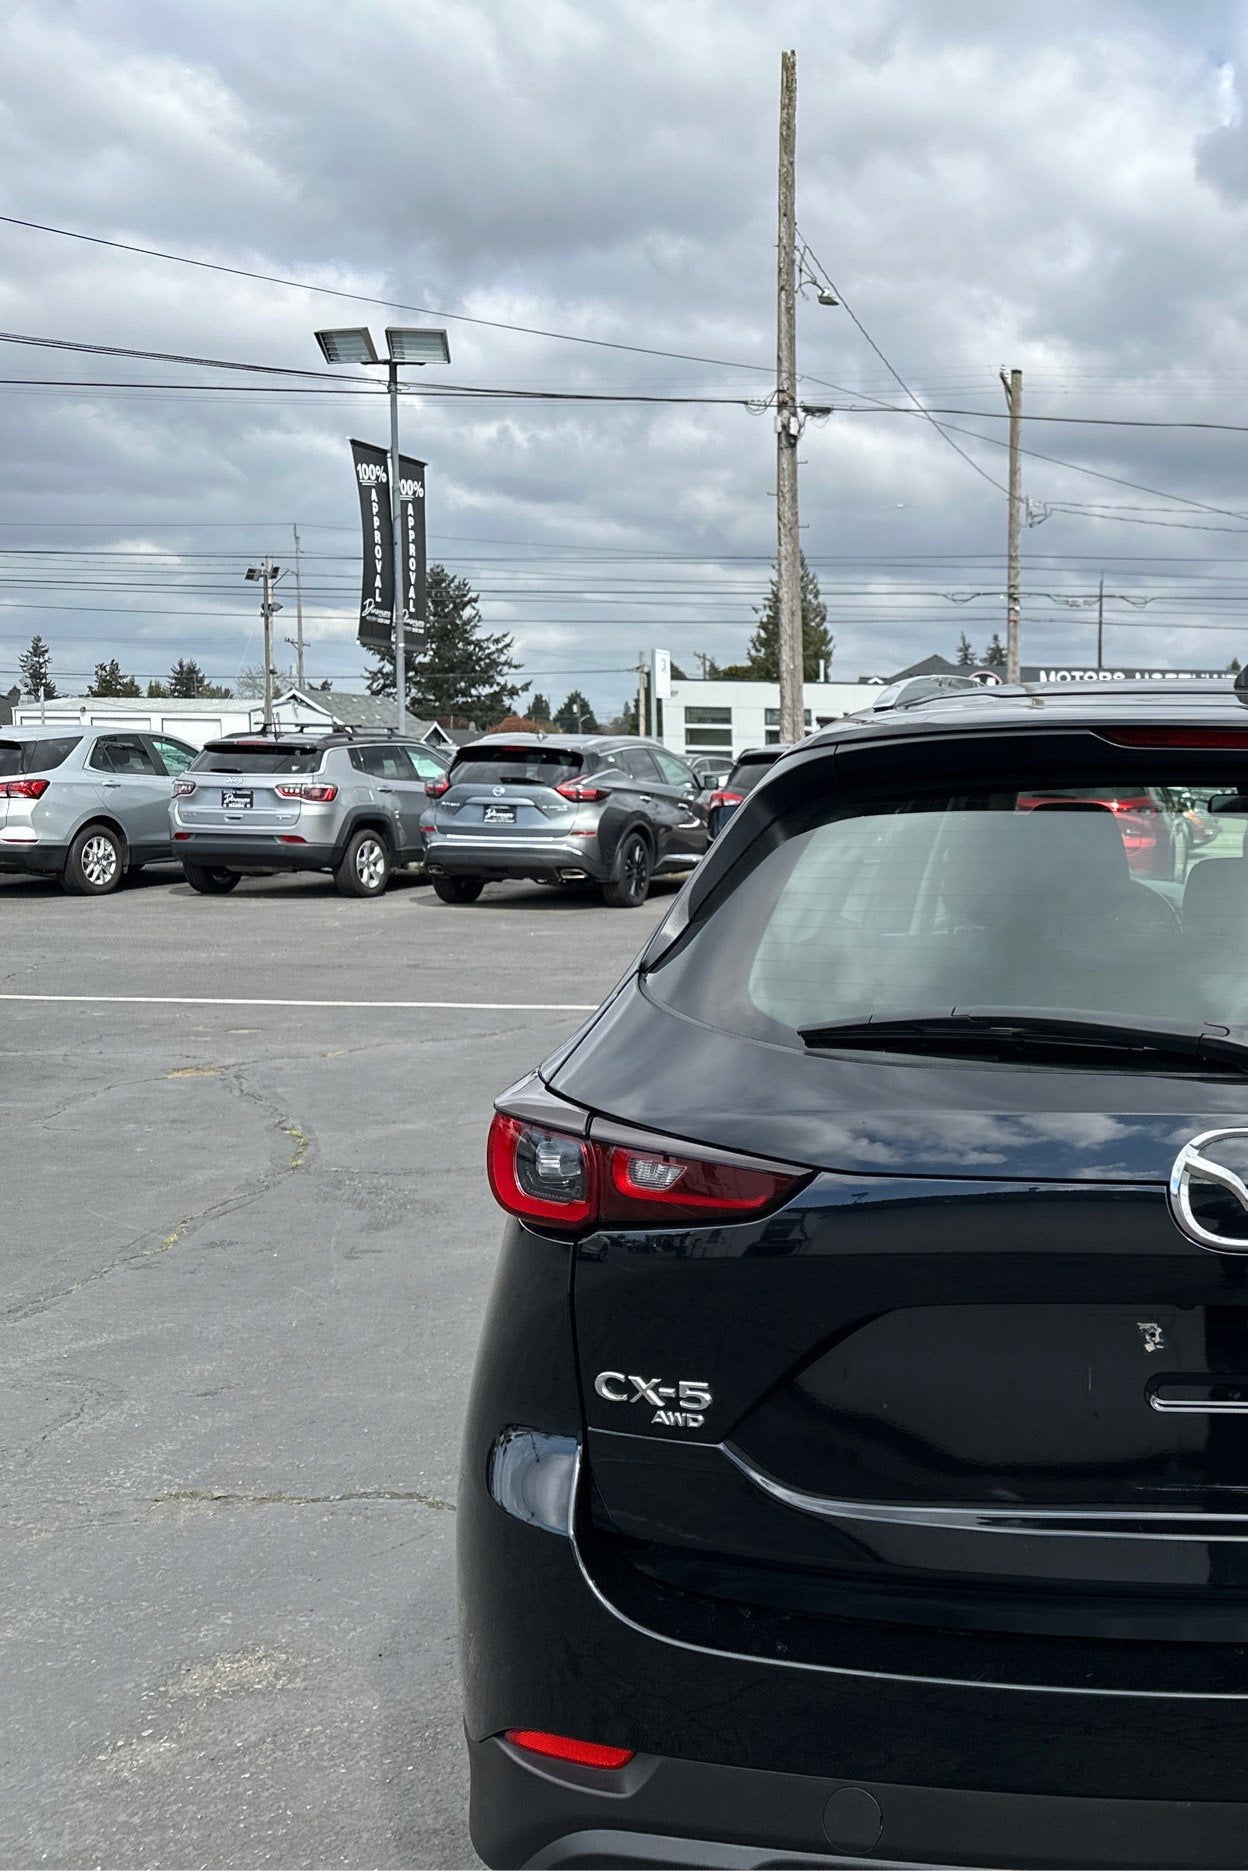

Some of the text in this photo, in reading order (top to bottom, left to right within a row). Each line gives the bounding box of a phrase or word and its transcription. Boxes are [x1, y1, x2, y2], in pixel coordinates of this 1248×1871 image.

[357, 463, 387, 482] 100%
[400, 479, 424, 497] 00%
[371, 488, 382, 602] APPROVAL
[407, 503, 416, 612] APPROVAL
[594, 1371, 713, 1410] CX-5
[651, 1410, 705, 1427] AWD
